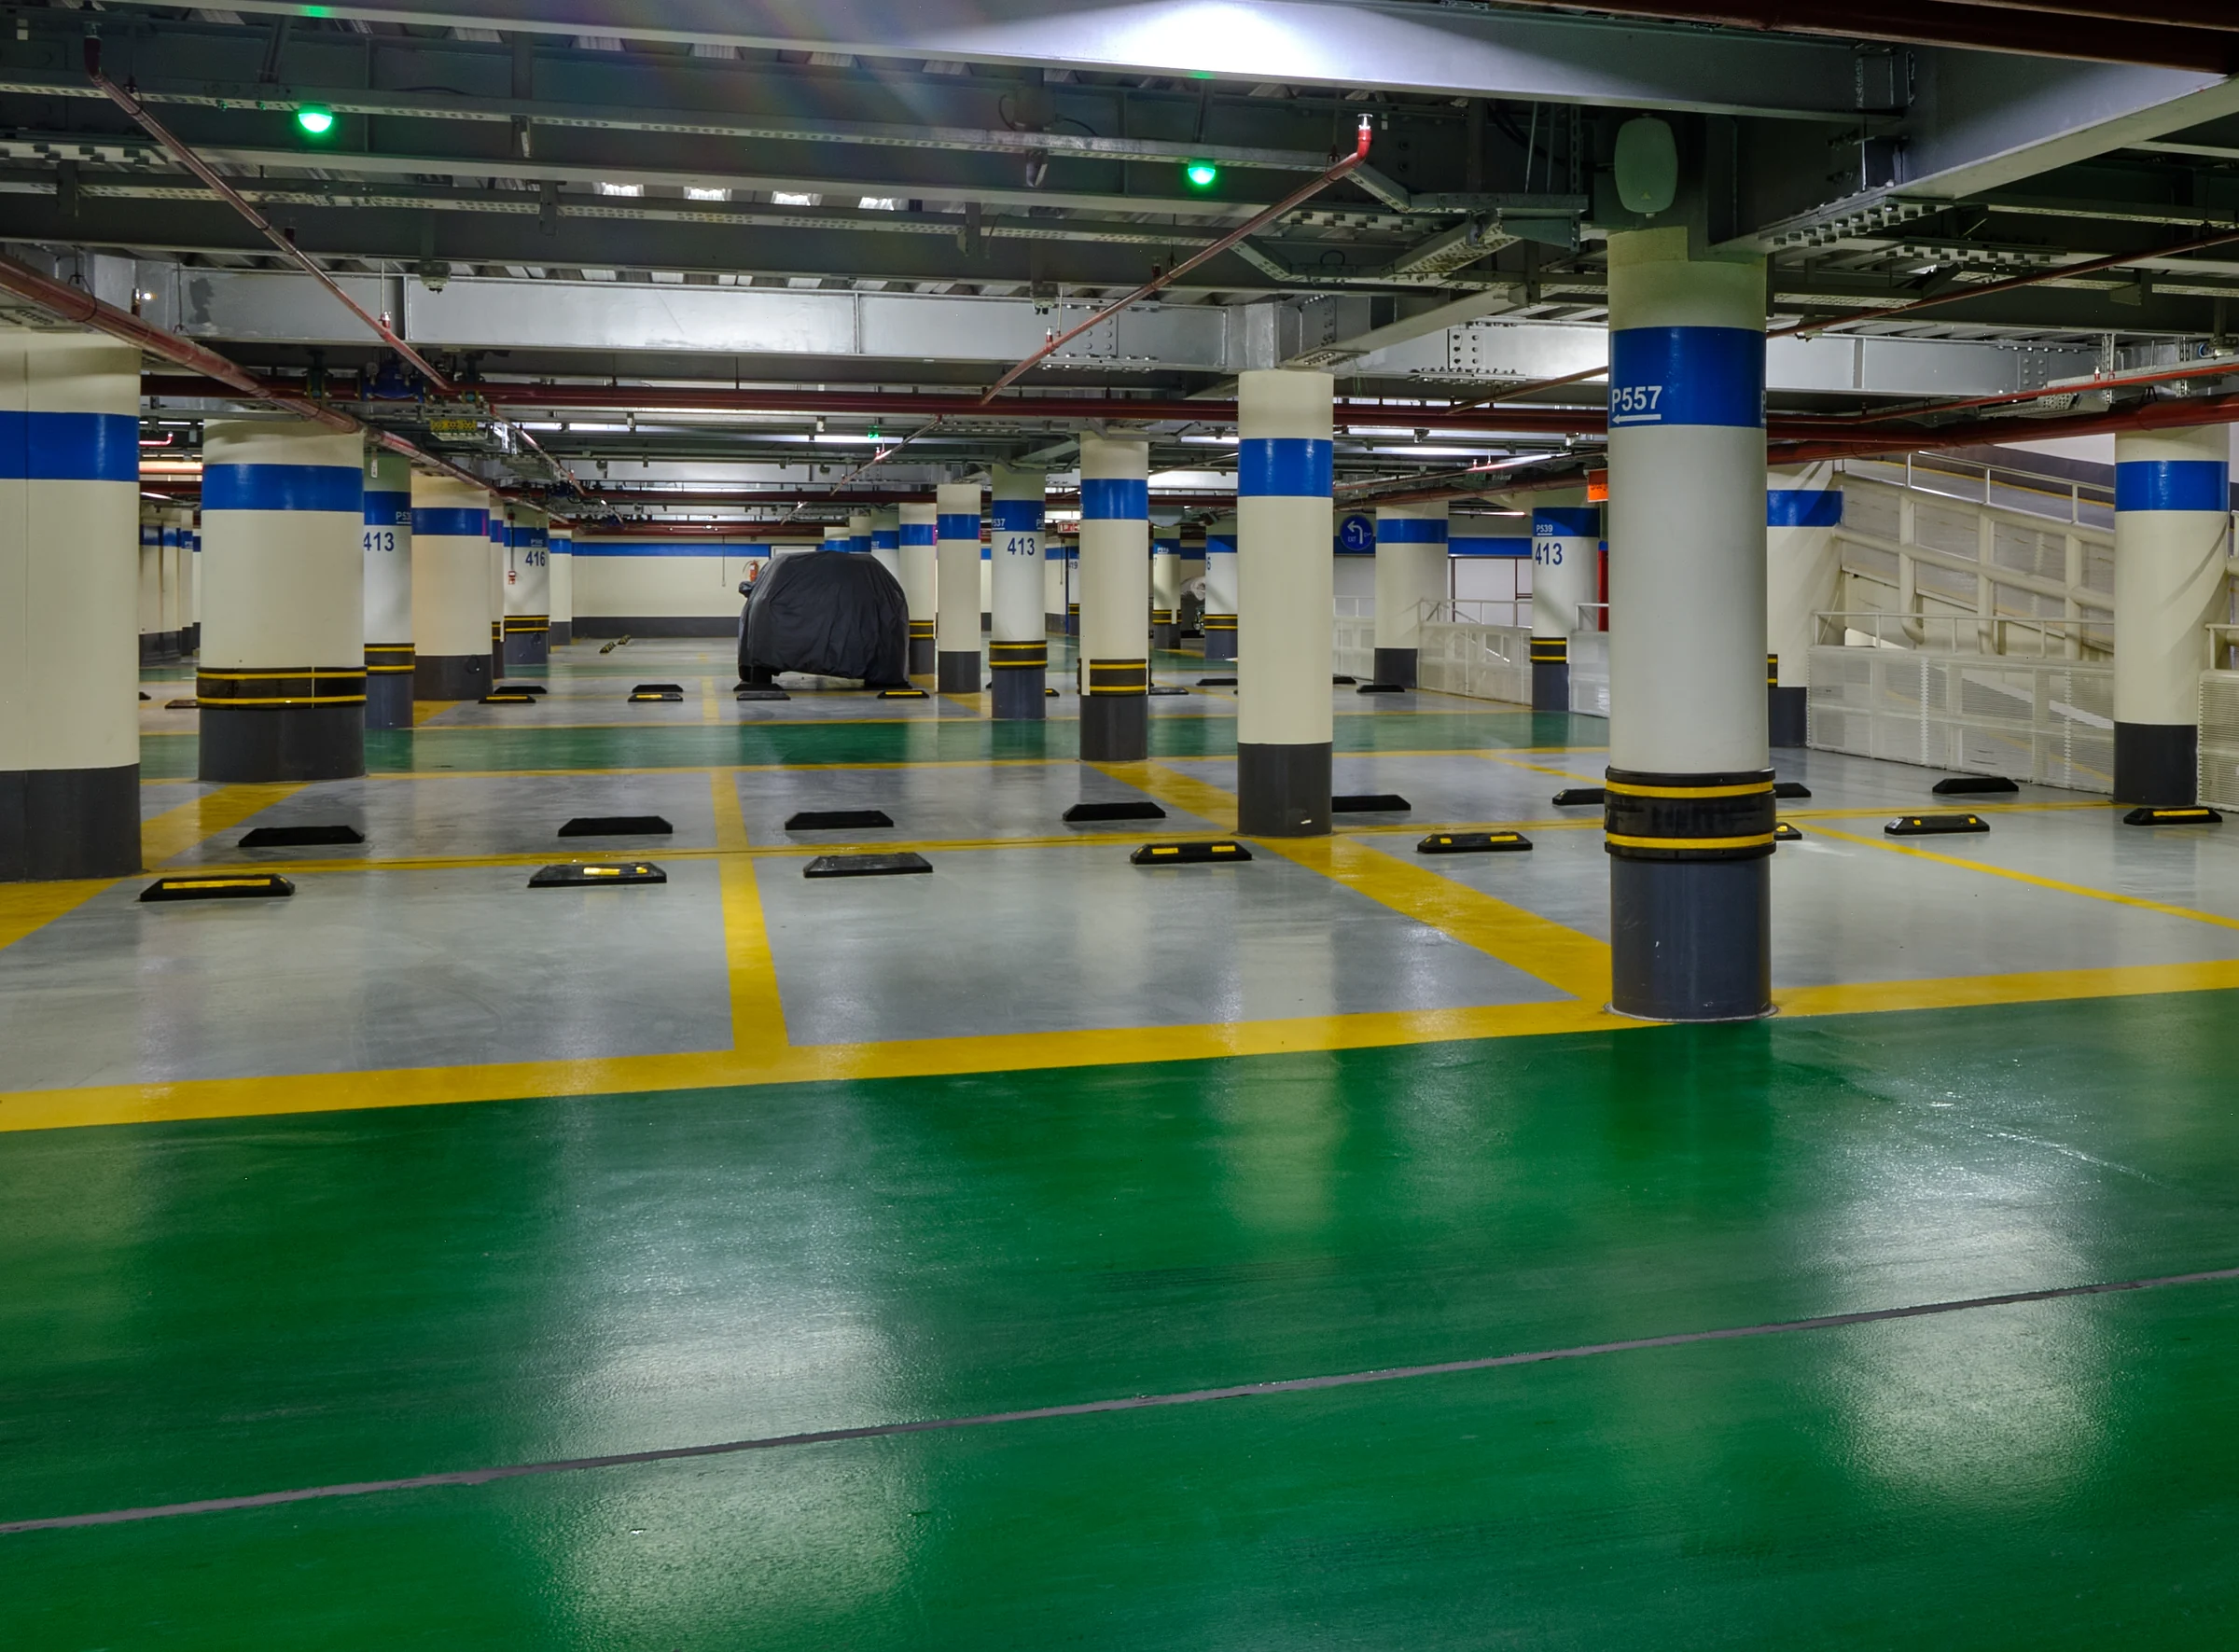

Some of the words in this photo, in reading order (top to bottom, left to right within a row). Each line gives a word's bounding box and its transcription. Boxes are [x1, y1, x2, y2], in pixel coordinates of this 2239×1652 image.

[1612, 385, 1662, 412] P557
[1536, 524, 1553, 533] P539
[364, 532, 395, 551] 413
[1007, 537, 1036, 556] 413
[525, 550, 546, 567] 416
[1536, 542, 1563, 565] 413
